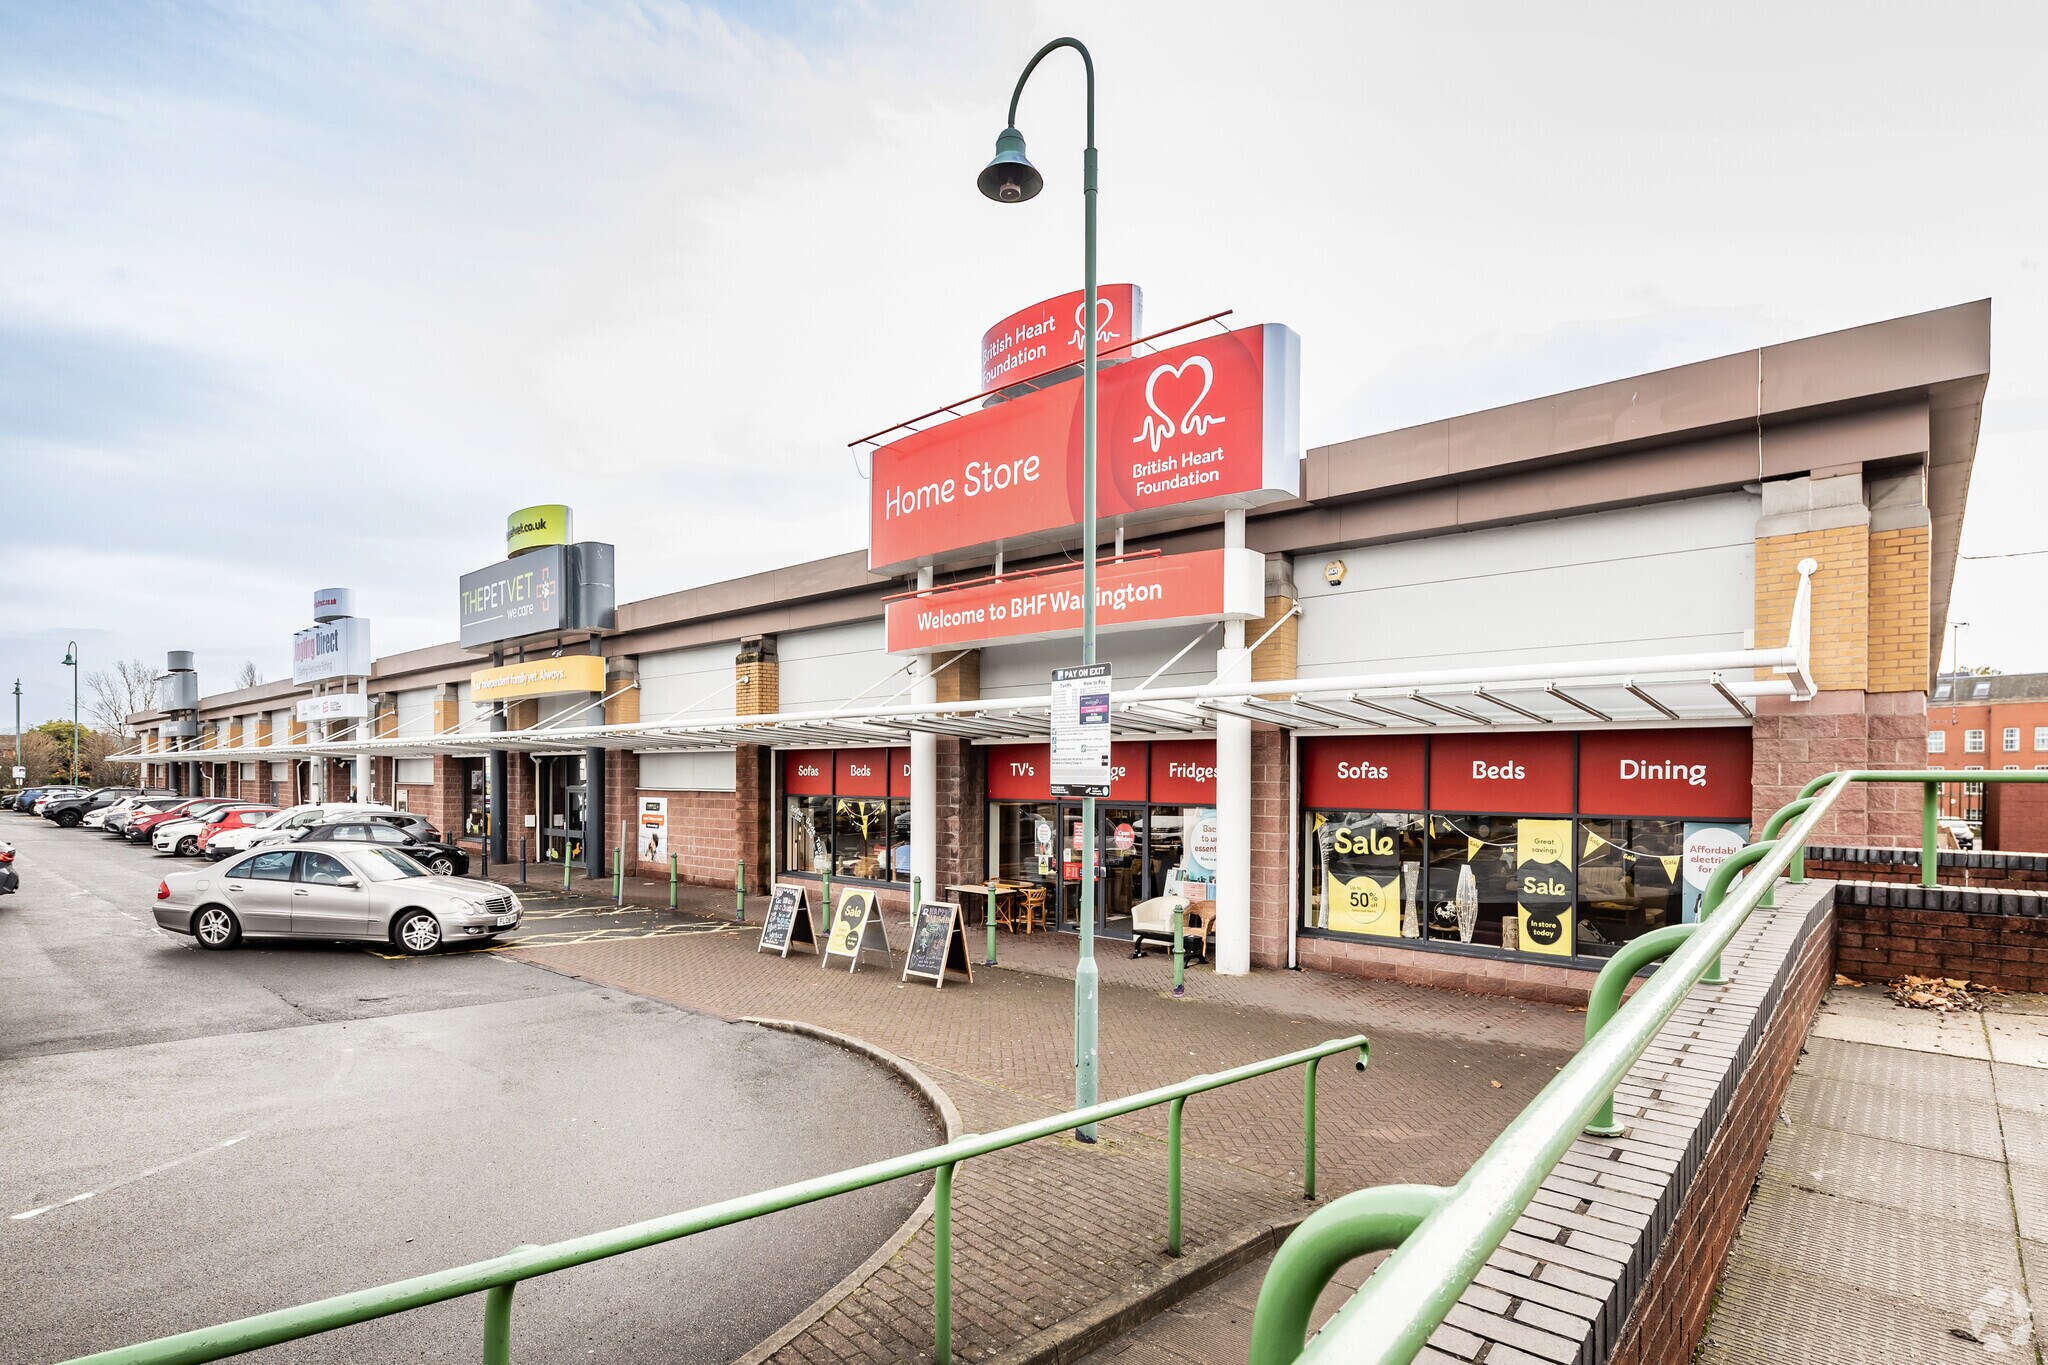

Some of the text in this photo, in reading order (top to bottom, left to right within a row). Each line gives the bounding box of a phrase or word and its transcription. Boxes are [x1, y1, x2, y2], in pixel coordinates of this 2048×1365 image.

[983, 315, 1056, 366] British Heart
[982, 345, 1047, 387] Foundation
[1132, 446, 1224, 478] British Heart
[885, 455, 1040, 521] Home Store
[1136, 469, 1219, 496] Foundation
[517, 604, 534, 617] care
[917, 583, 1162, 631] Welcome to BHF Waington
[316, 629, 338, 656] Direct
[510, 672, 528, 685] family
[528, 670, 538, 681] vet.
[540, 668, 566, 681] Always.
[1064, 670, 1077, 679] PAY
[1078, 669, 1088, 677] ON
[1089, 666, 1105, 676] EXIT
[798, 764, 819, 777] Sofas
[850, 764, 871, 777] Beds
[1010, 762, 1034, 777] TV's
[1337, 761, 1388, 779] Sofas
[1472, 760, 1525, 780] Beds
[1620, 759, 1707, 787] Dining
[1203, 824, 1217, 833] Bac
[1442, 822, 1452, 832] Sale
[1333, 827, 1394, 856] Sale
[1469, 840, 1480, 849] Sale
[1588, 836, 1601, 847] Sale
[1531, 846, 1557, 854] savings
[1690, 845, 1737, 855] Affordabl
[1623, 853, 1637, 863] Sale
[1698, 865, 1712, 873] for
[1523, 876, 1566, 896] Sale
[1350, 892, 1378, 908] 50%
[844, 905, 862, 918] Sale
[1538, 920, 1557, 929] store
[1533, 928, 1554, 938] today
